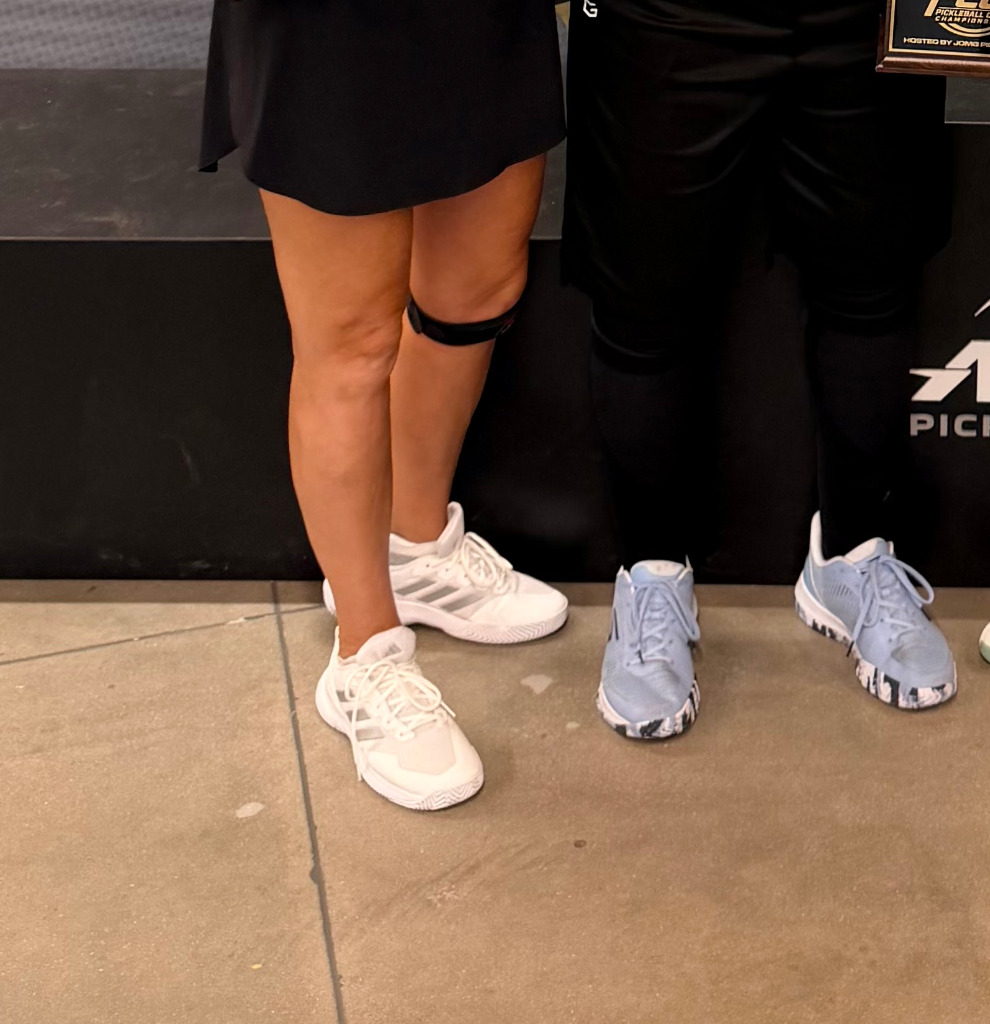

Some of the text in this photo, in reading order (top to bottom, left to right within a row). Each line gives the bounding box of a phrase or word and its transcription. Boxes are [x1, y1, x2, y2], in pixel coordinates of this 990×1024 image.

[935, 8, 984, 19] PICKLEBALL
[903, 36, 939, 45] HOSTED
[940, 38, 952, 46] BY
